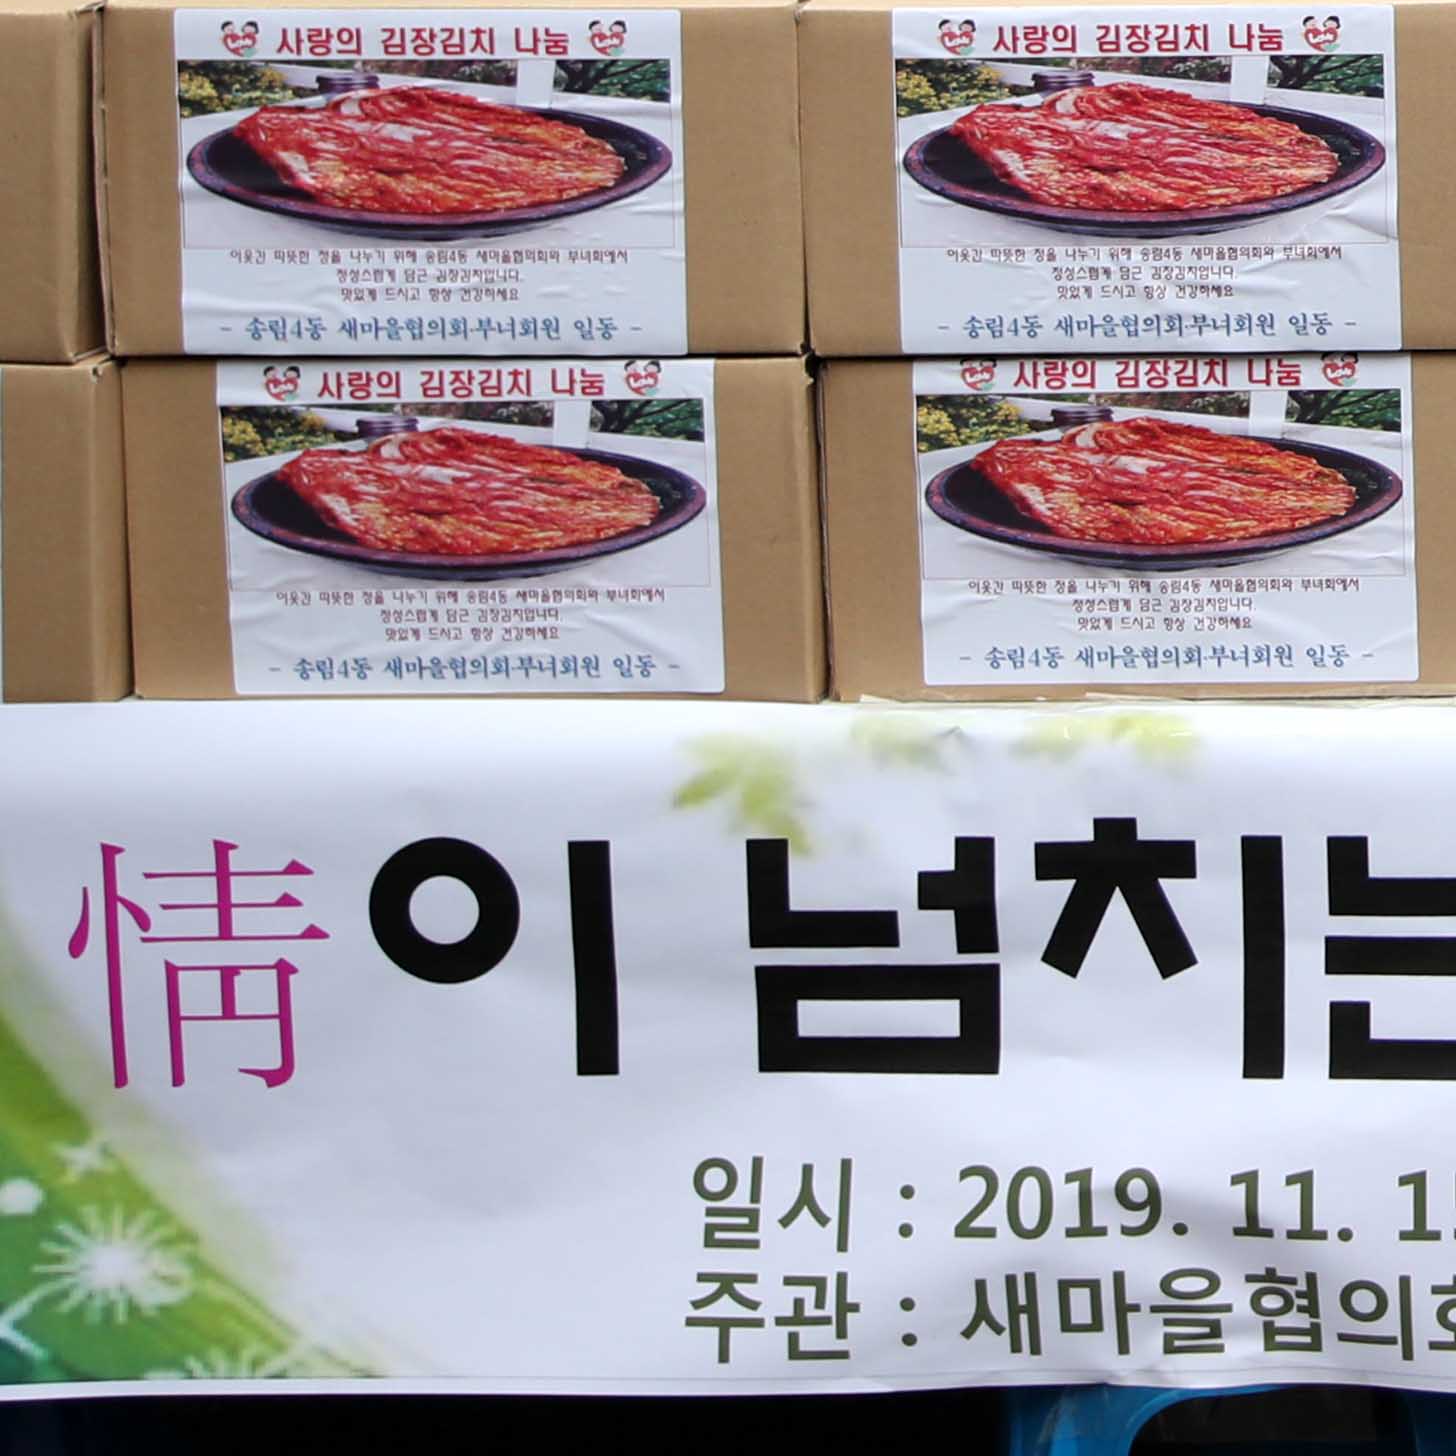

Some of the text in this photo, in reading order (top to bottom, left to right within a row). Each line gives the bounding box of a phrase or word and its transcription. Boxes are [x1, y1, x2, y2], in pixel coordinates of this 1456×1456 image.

[277, 28, 568, 56] 사랑의 김장김치 나눔
[993, 24, 1283, 54] 사랑의 김장김치 나눔
[246, 317, 326, 341] 송림4동
[574, 317, 618, 340] 일동
[964, 315, 1043, 339] 송림4동
[1289, 313, 1332, 336] 일동
[318, 368, 604, 400] 사랑의 김장김치 나눔
[1014, 359, 1301, 389] 사랑의 김장김치 나눔
[294, 657, 372, 680] 송림4동
[613, 655, 656, 678] 일동
[985, 646, 1064, 669] 송림4동
[1306, 645, 1349, 667] 일동
[694, 1157, 852, 1252] 일시
[954, 1165, 1189, 1240] 2019.
[1230, 1170, 1353, 1242] 11.
[685, 1271, 860, 1363] 주관
